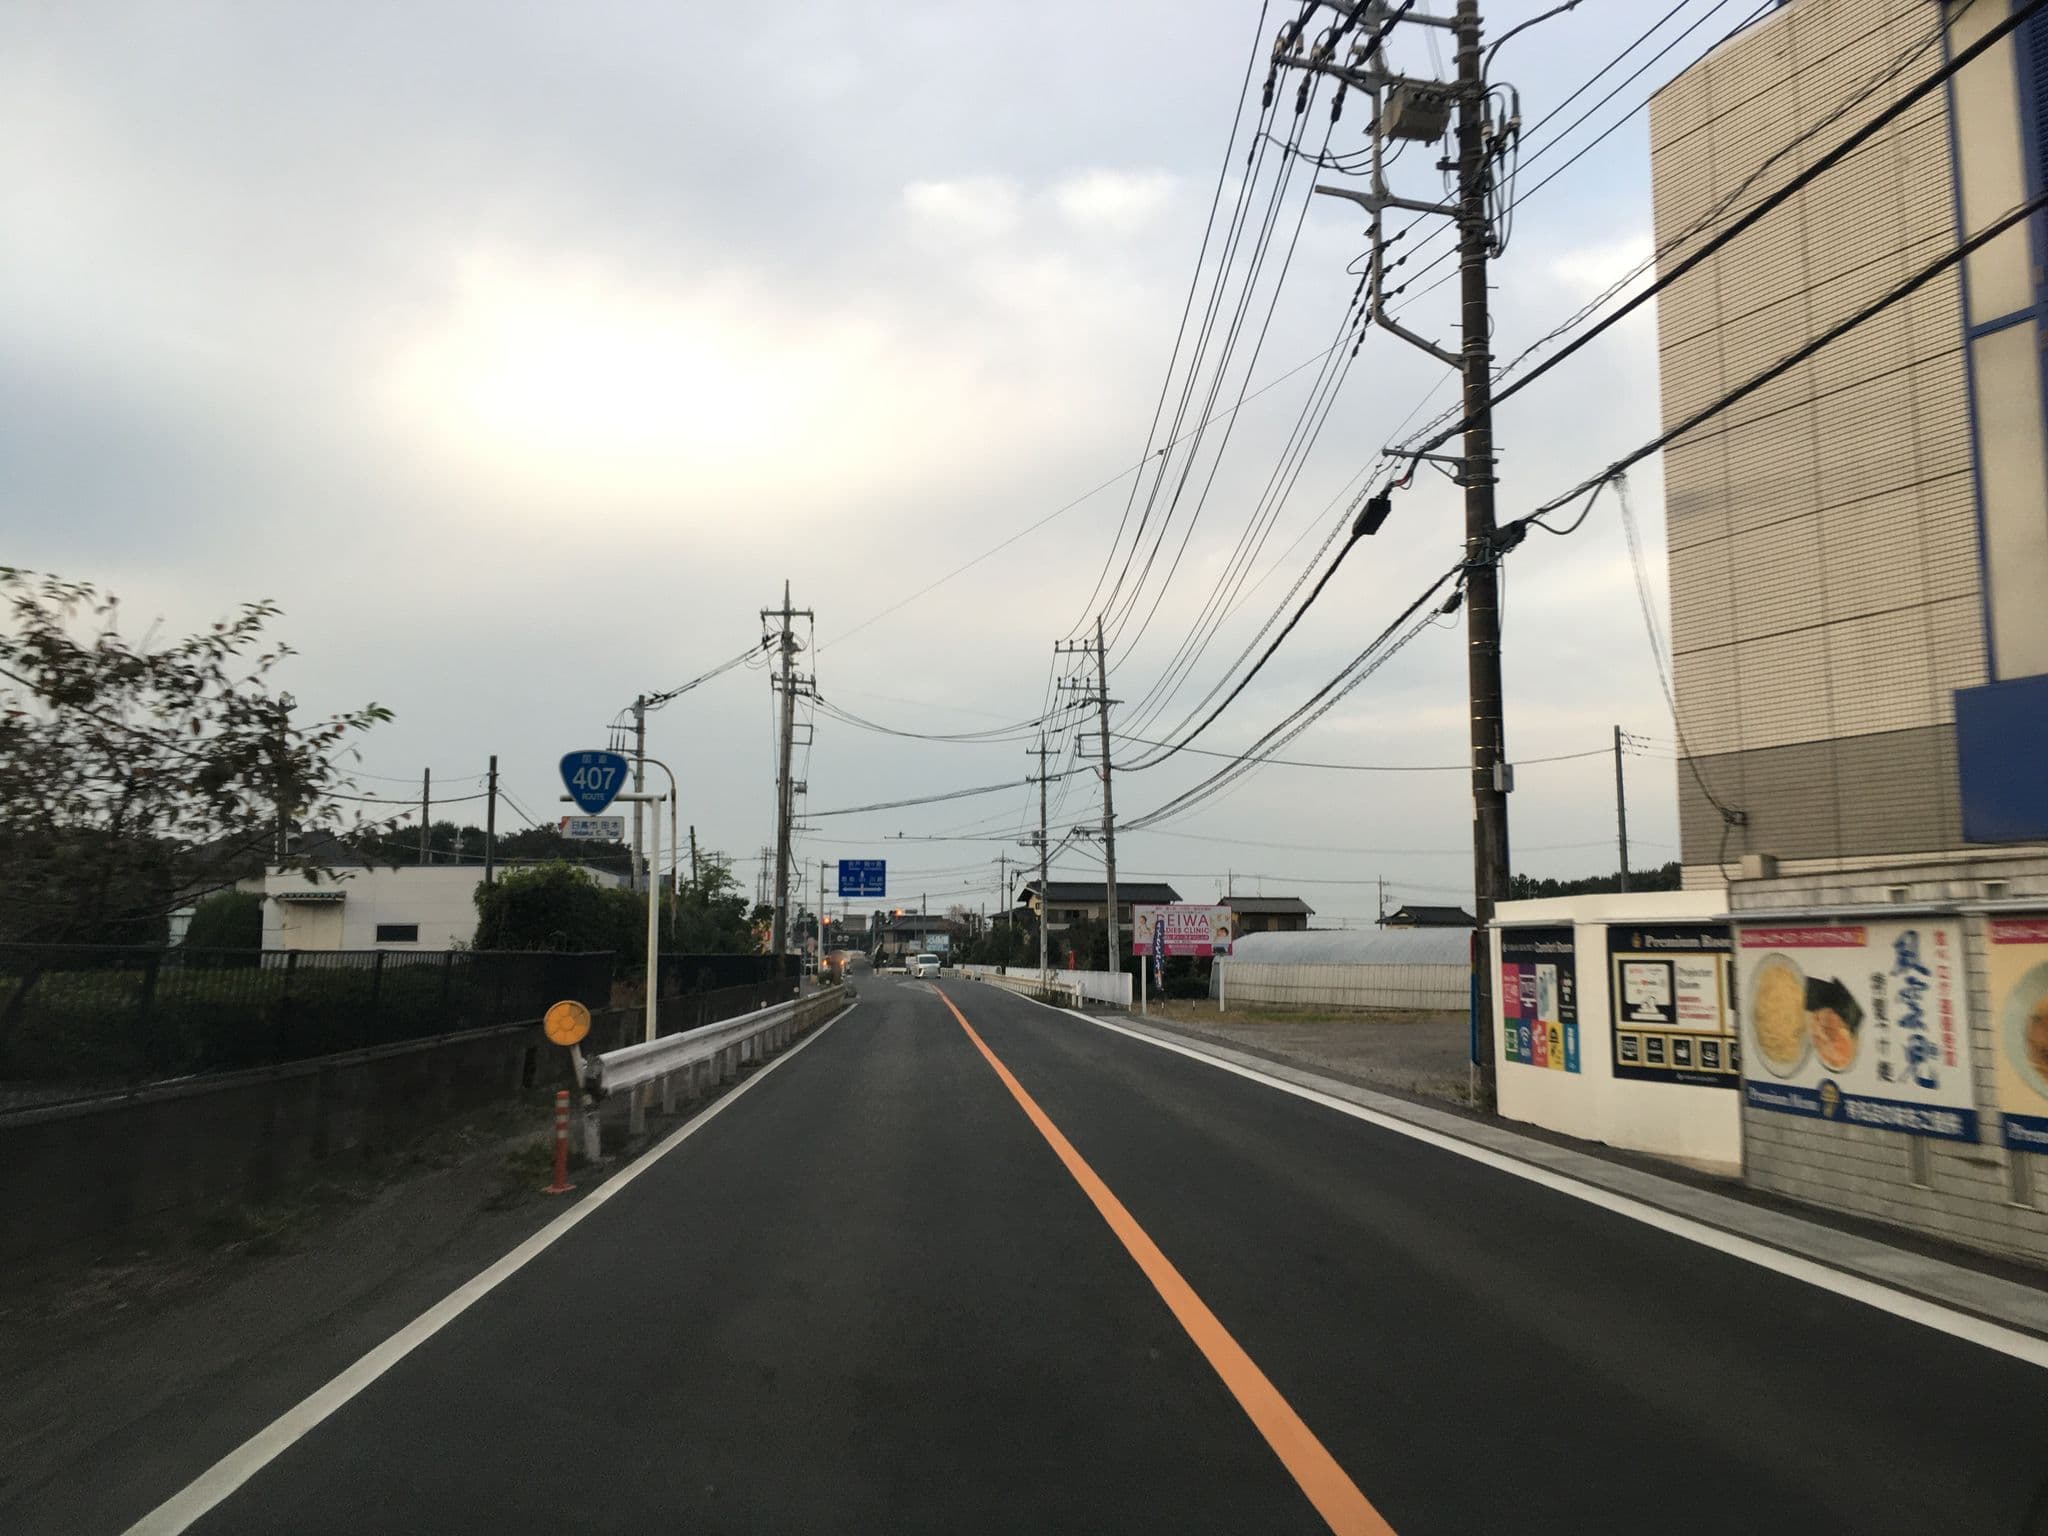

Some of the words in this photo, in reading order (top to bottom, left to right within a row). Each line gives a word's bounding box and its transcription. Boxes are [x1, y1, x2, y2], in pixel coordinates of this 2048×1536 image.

[572, 767, 616, 790] 407
[582, 793, 605, 801] ROUTE
[1644, 934, 1700, 947] Premium
